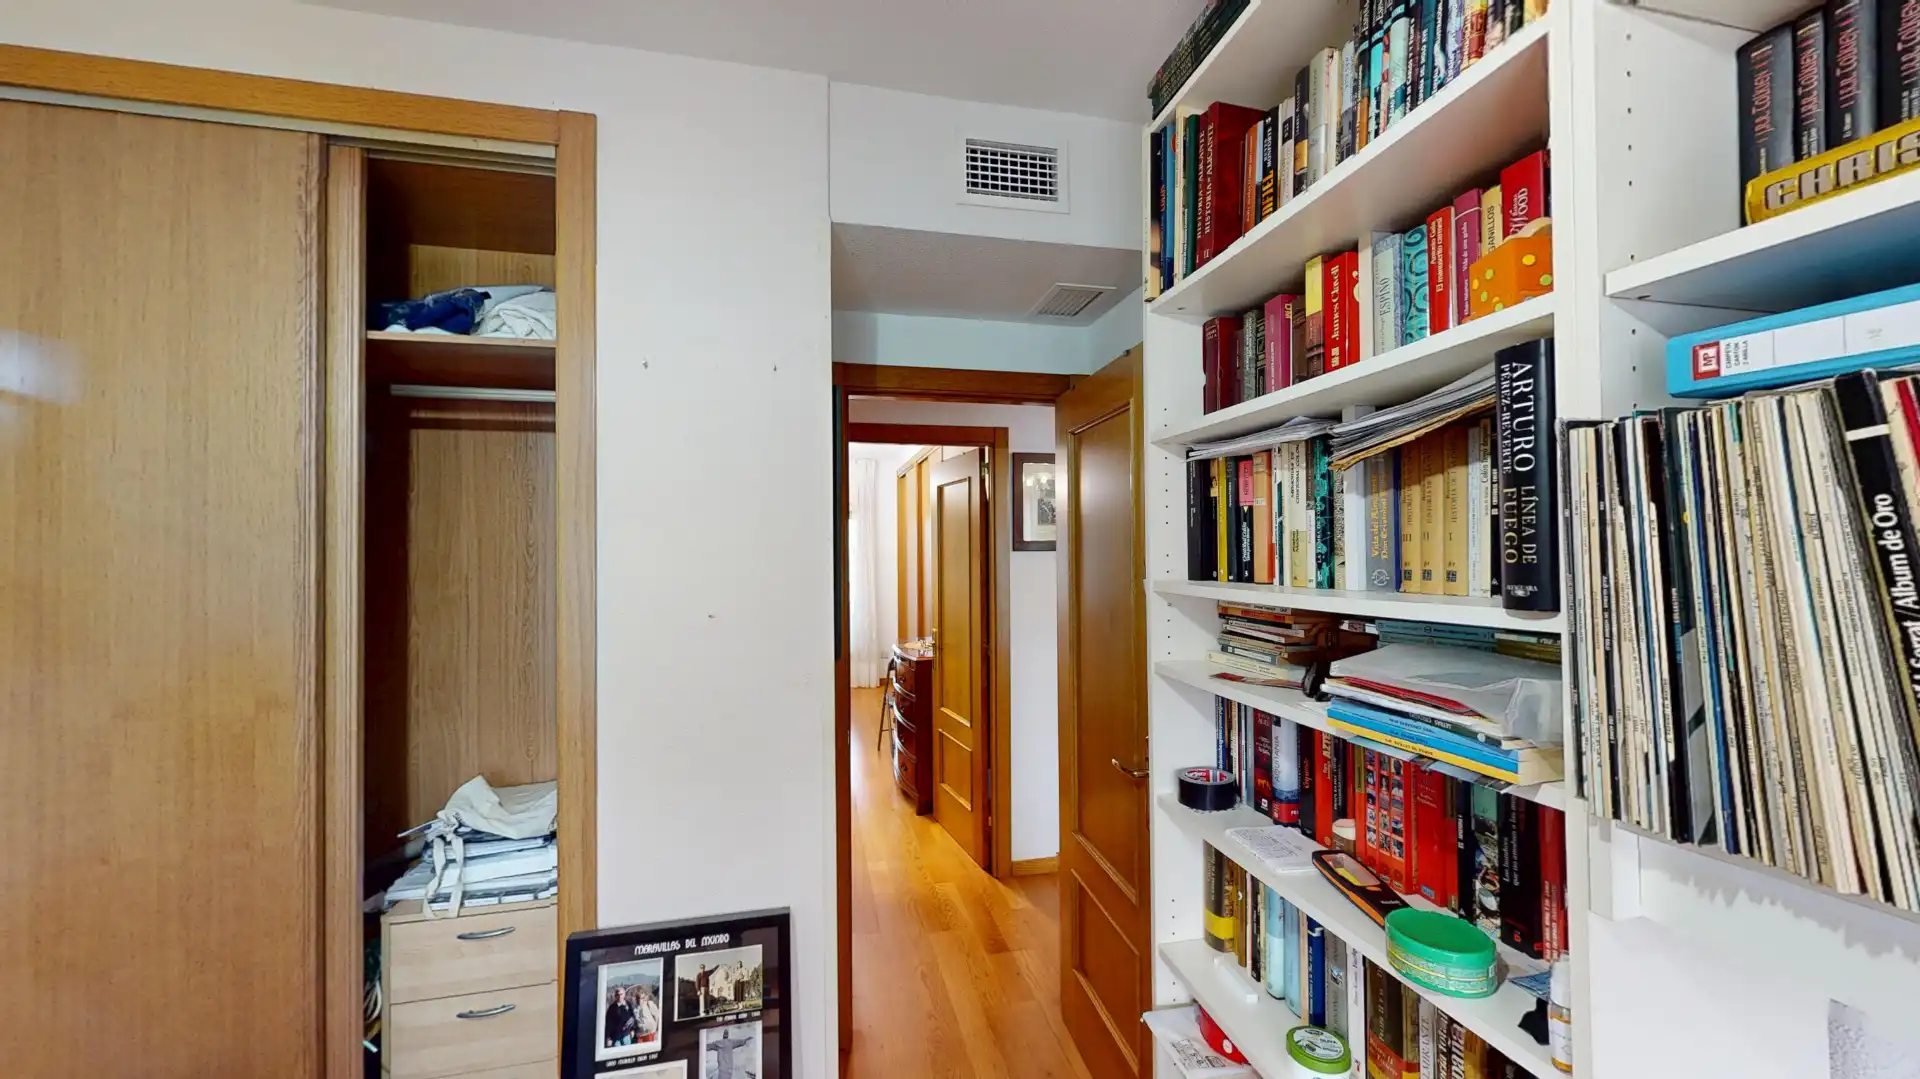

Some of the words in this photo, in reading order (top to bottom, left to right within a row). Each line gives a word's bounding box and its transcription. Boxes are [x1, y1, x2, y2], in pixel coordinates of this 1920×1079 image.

[1835, 27, 1860, 76] TOLKIEN
[1797, 47, 1820, 94] TOLKIEN
[1751, 69, 1773, 113] TOLKIEN
[1206, 122, 1214, 176] ALICANTE
[1204, 182, 1213, 234] HISTORIA
[1330, 264, 1340, 303] Clavell
[1379, 277, 1391, 316] ESPINO
[1330, 304, 1340, 341] James
[1500, 363, 1513, 474] PÉREZ-REVERTE
[1511, 362, 1536, 472] ARTURO
[1480, 464, 1489, 483] Colón
[1370, 521, 1379, 534] del
[1503, 487, 1518, 564] FUEGO
[1521, 485, 1539, 537] LÍNEA
[1872, 493, 1899, 528] Oro
[1371, 536, 1379, 557] Vida
[1381, 541, 1389, 558] Don
[1402, 533, 1412, 542] III
[1423, 532, 1430, 541] II
[1522, 544, 1538, 564] DE
[1878, 529, 1905, 551] de
[1889, 553, 1920, 610] Album
[1322, 732, 1332, 759] AZTE
[1512, 862, 1519, 871] no
[1512, 872, 1520, 886] que
[634, 940, 681, 955] MARAVILLAS
[685, 937, 697, 949] DEL
[701, 933, 730, 947] MUNDO
